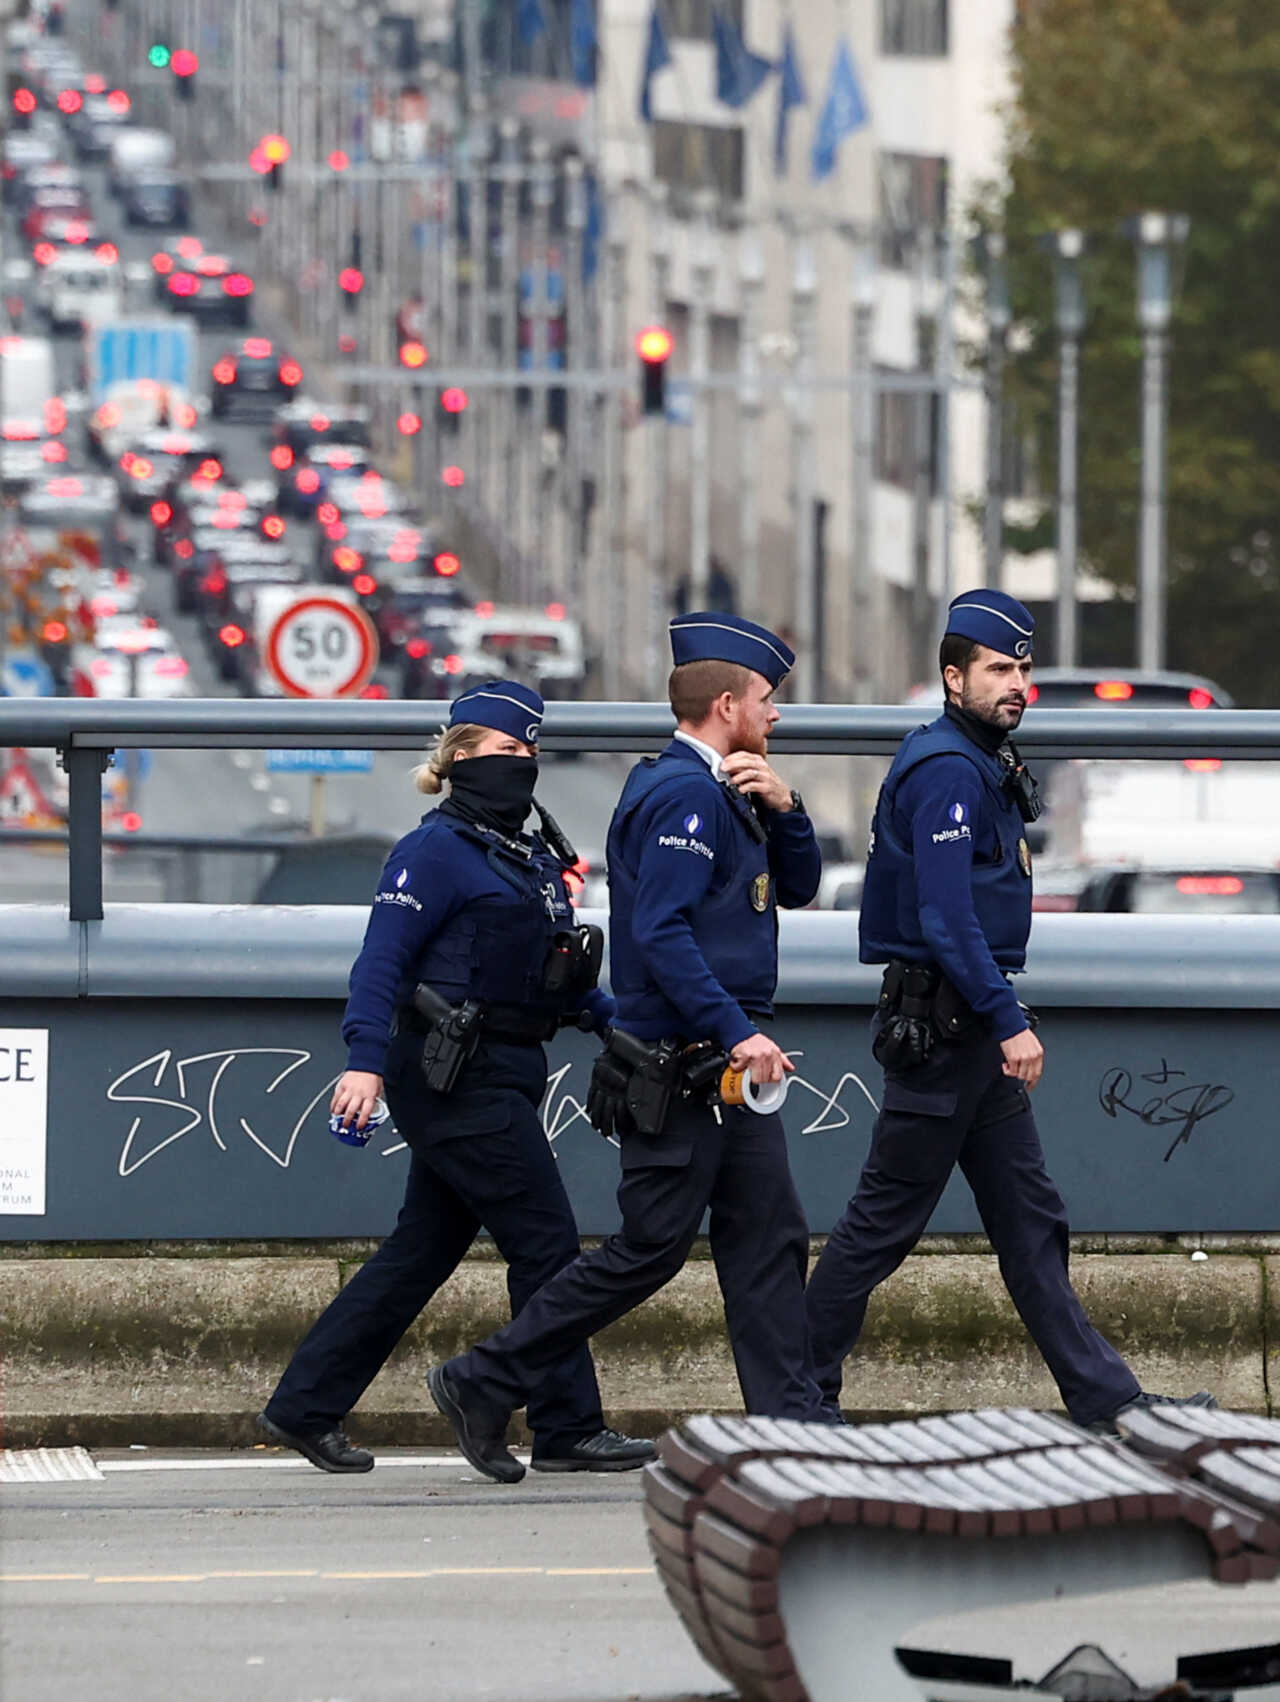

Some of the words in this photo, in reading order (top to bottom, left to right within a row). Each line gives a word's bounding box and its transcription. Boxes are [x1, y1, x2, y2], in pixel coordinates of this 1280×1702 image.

[292, 622, 348, 661] 50
[659, 835, 688, 846] Police
[689, 838, 714, 860] Politie
[932, 829, 960, 843] Police
